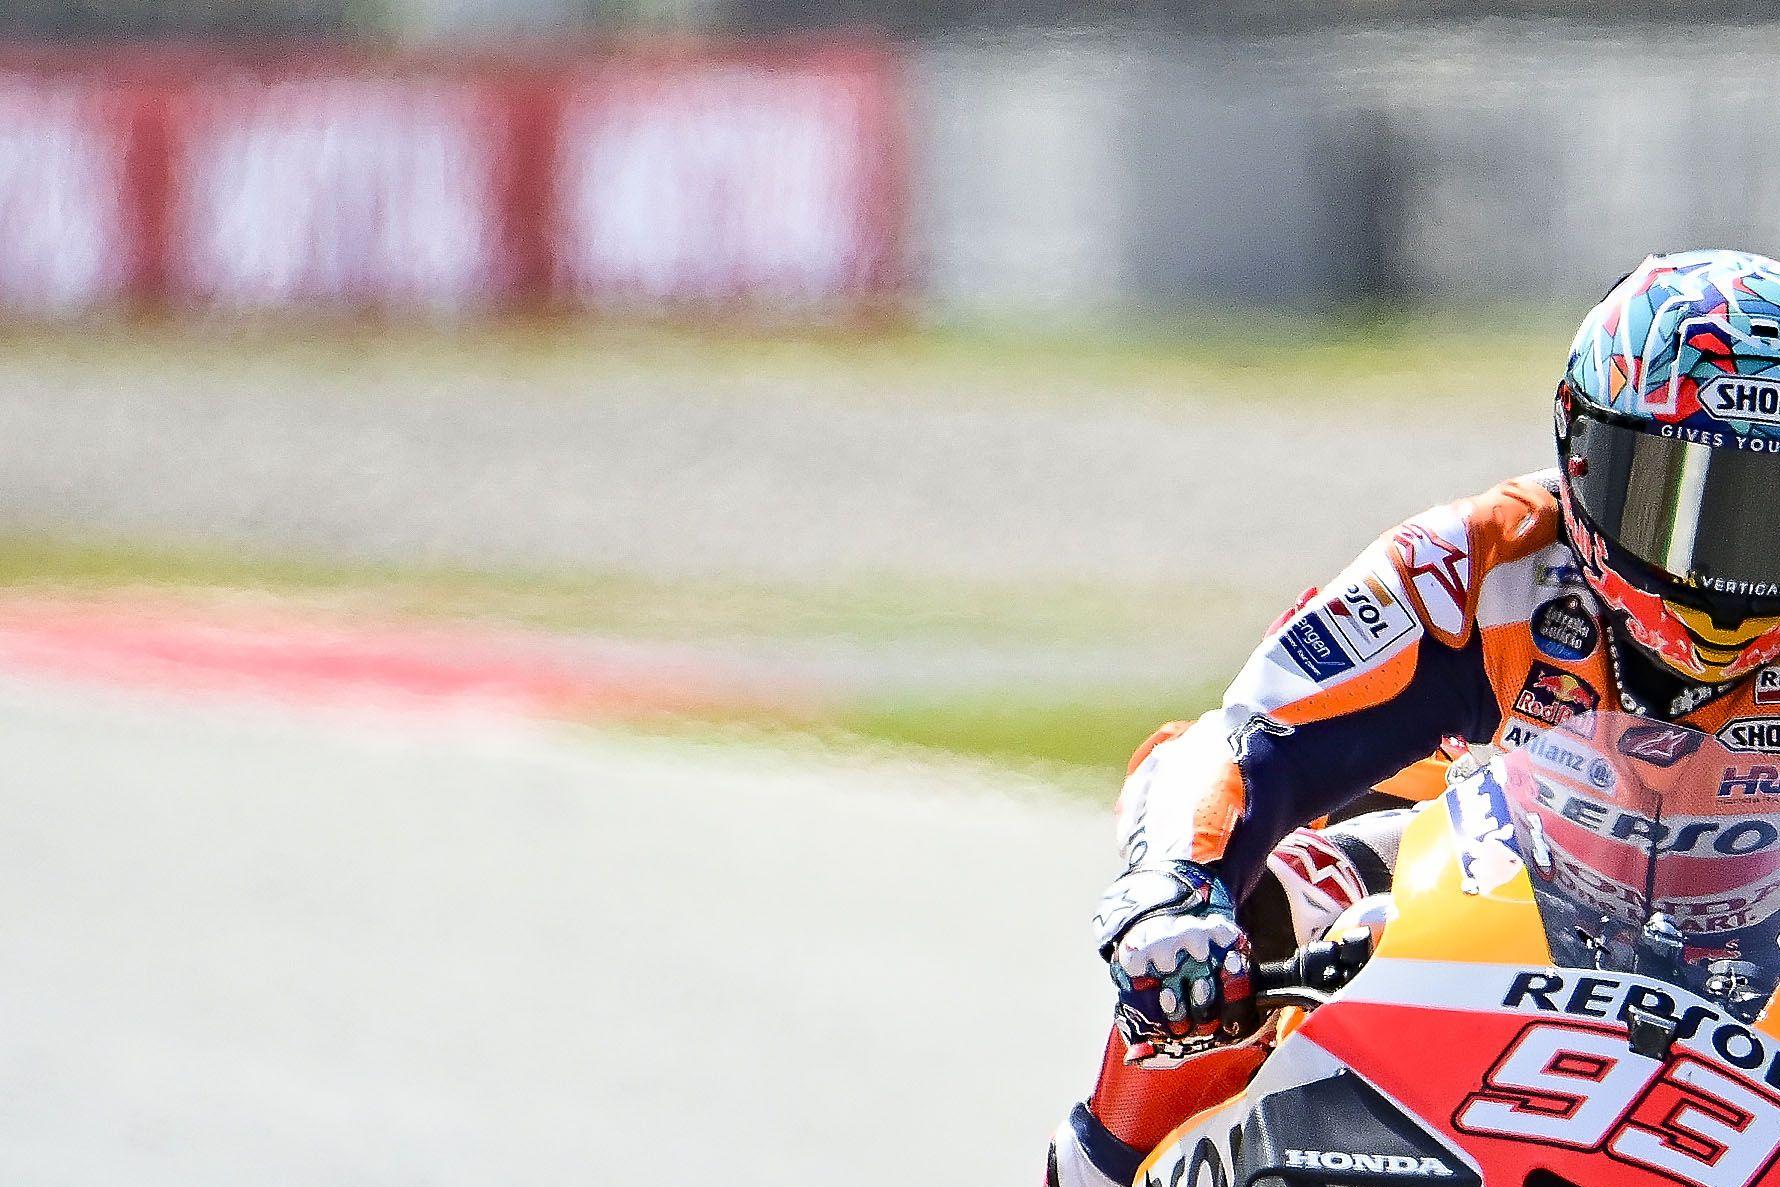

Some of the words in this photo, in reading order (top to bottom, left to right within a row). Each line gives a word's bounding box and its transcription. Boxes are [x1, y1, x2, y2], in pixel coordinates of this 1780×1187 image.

[1661, 425, 1724, 448] GIVES
[1736, 436, 1780, 454] YOU
[1284, 1148, 1454, 1176] HONDA
